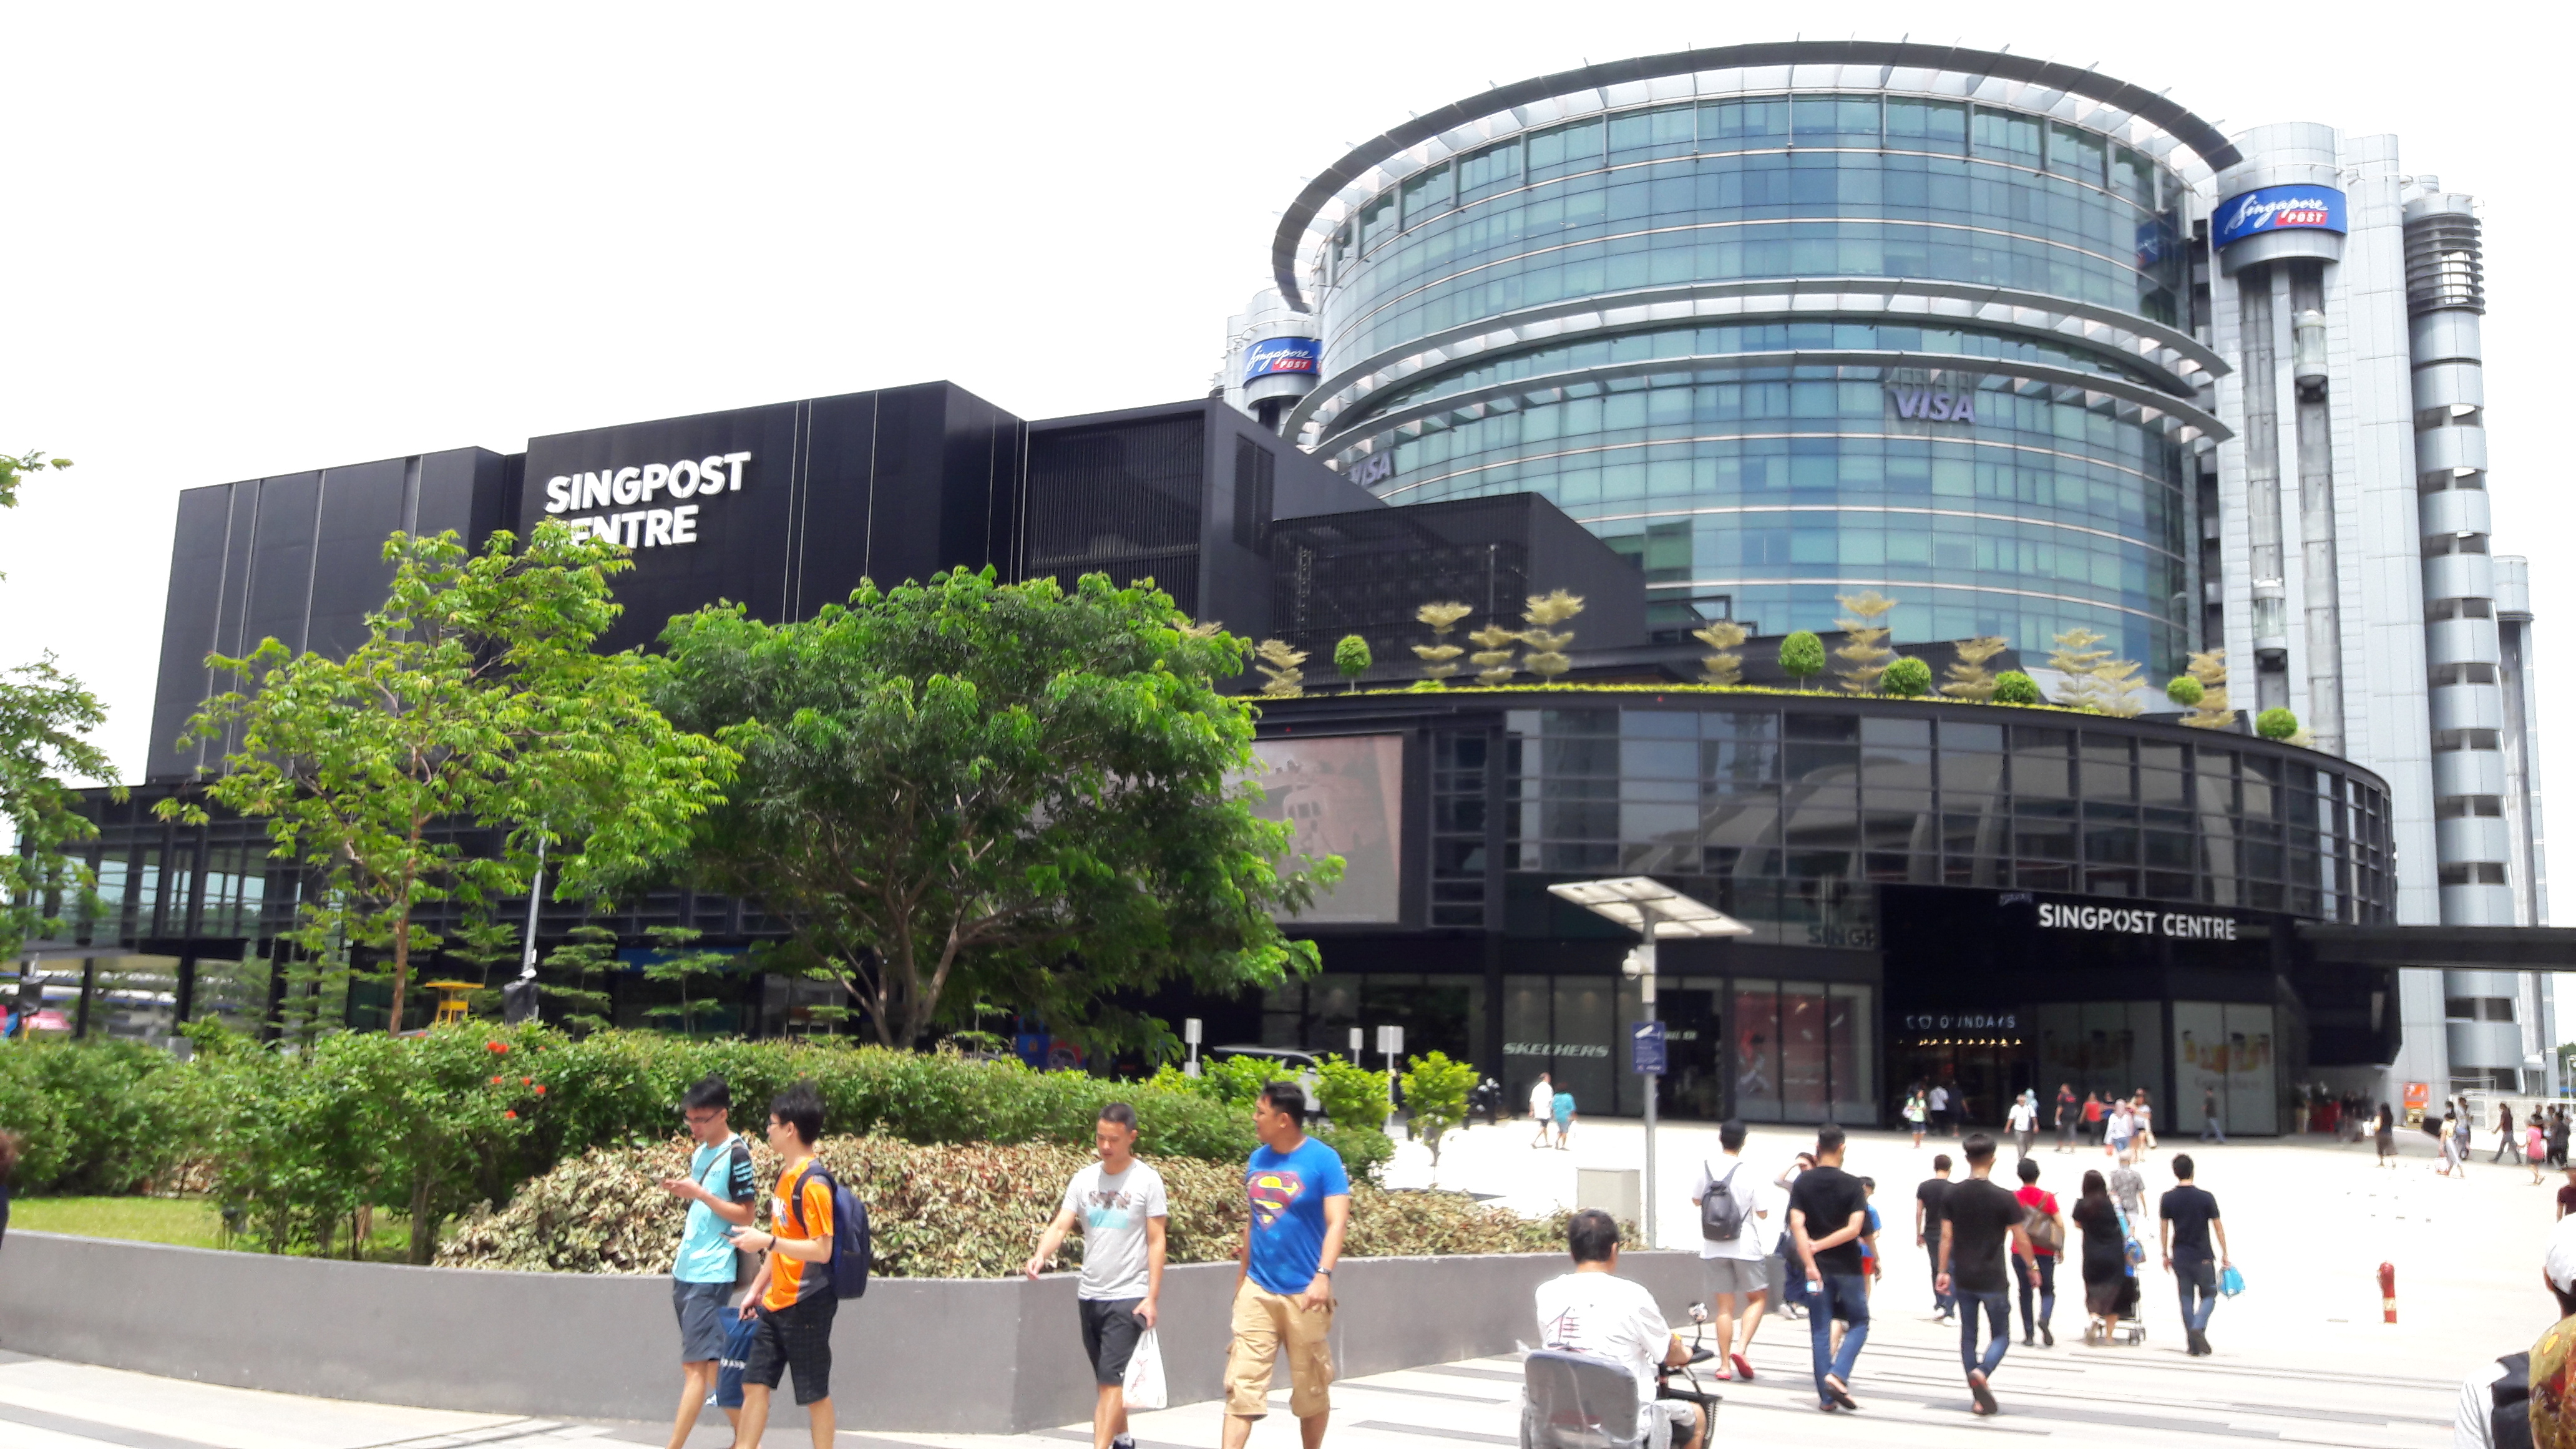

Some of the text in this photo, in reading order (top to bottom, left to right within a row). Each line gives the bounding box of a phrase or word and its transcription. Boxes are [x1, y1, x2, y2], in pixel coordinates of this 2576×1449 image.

[2223, 193, 2329, 235] Singapore
[2287, 212, 2323, 223] POST
[1246, 344, 1313, 374] Singapore
[1279, 360, 1308, 369] POST
[1891, 389, 1976, 423] VISA
[544, 451, 751, 514] SINGPOST
[555, 504, 699, 550] ENTRE
[2038, 903, 2237, 940] SINGPOST CENTRE
